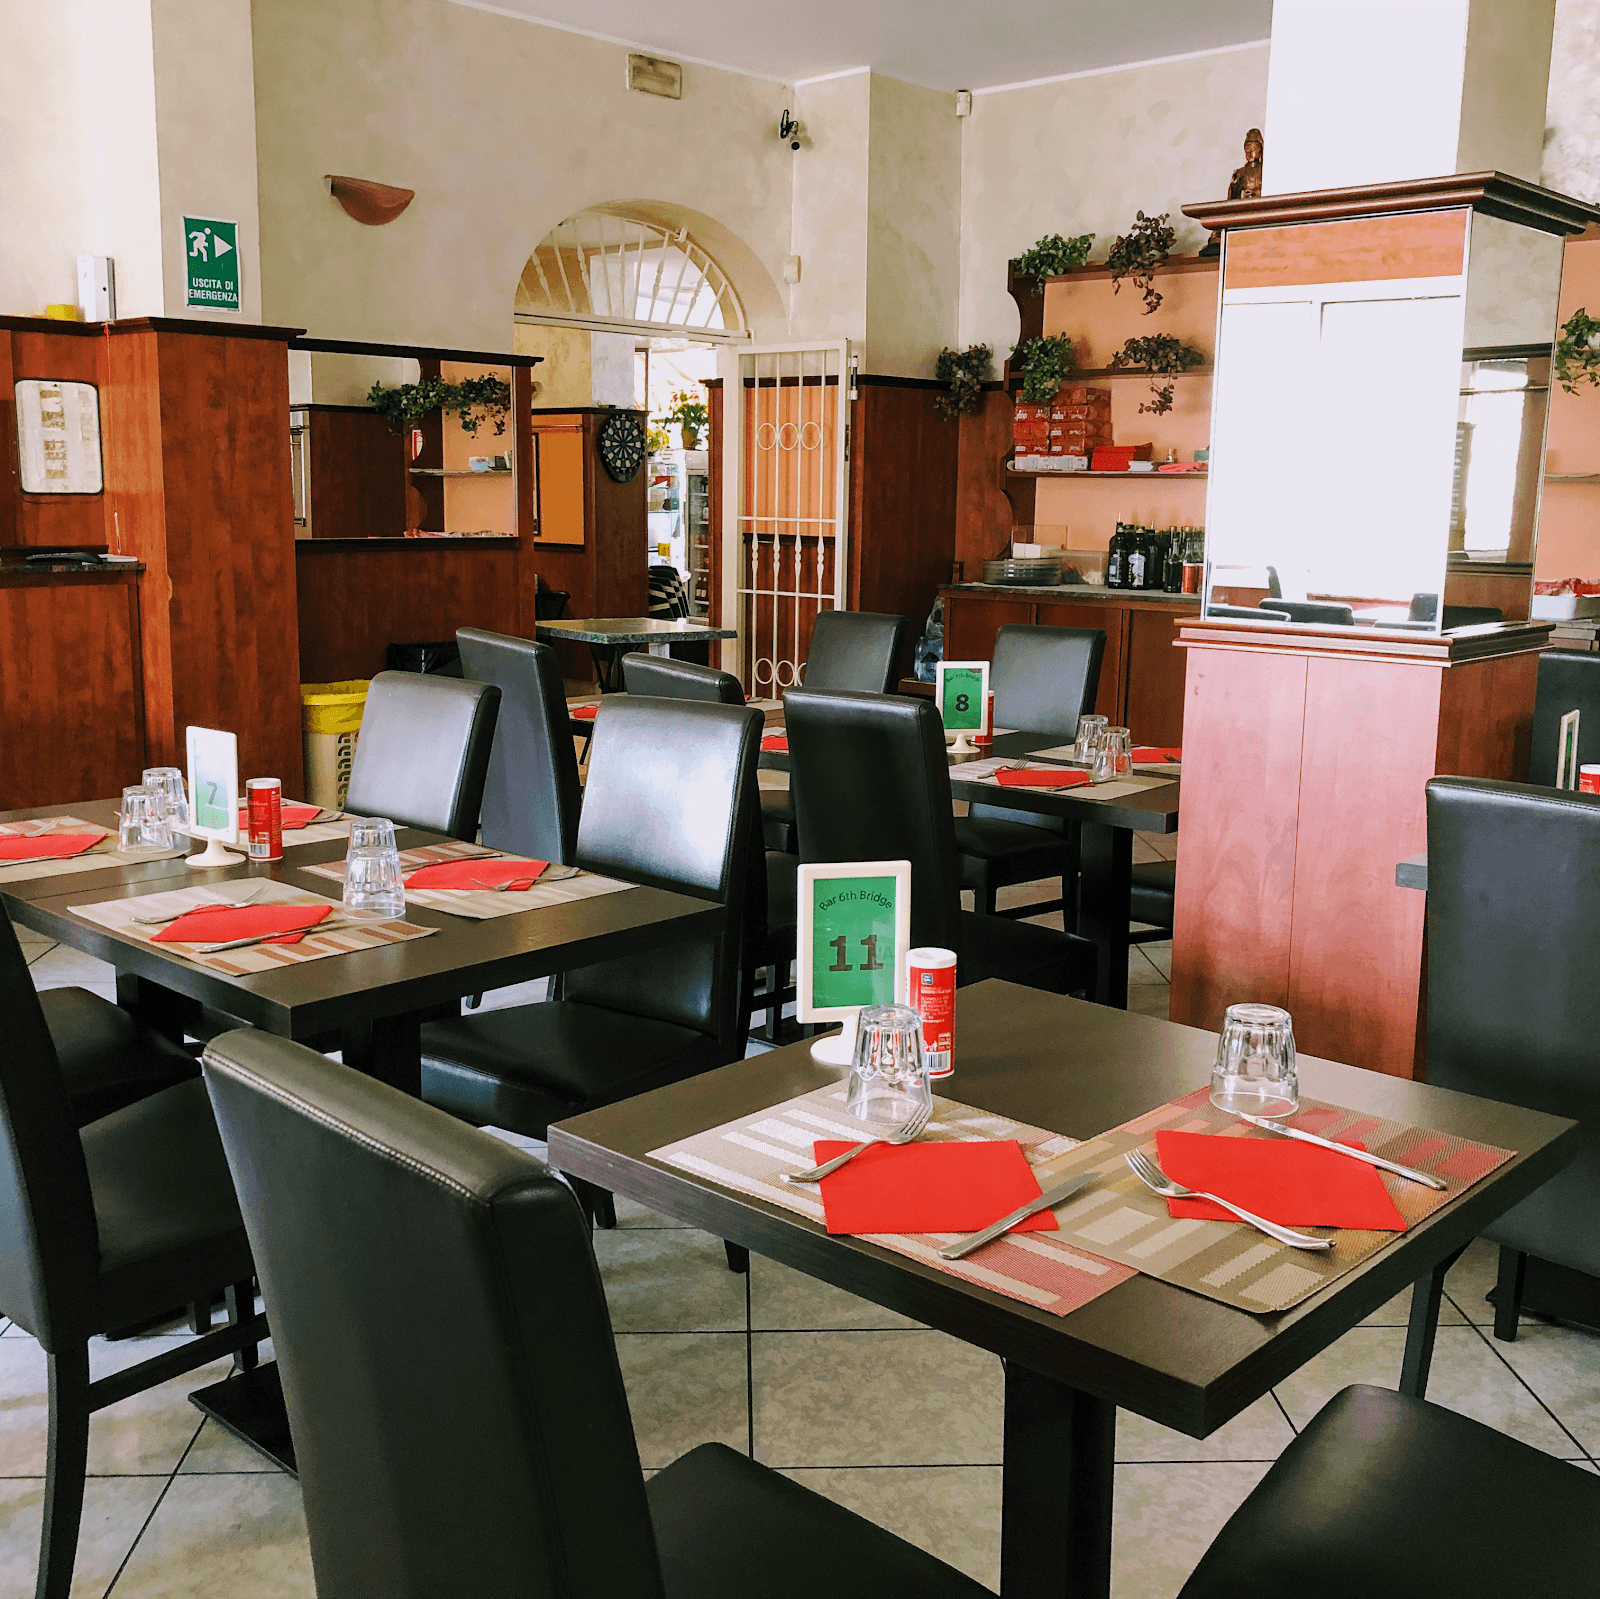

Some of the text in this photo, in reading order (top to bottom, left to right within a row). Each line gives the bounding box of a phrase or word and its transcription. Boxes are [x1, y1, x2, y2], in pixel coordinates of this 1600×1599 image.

[192, 277, 234, 291] USCITA DI
[188, 288, 238, 302] EMERGENZA
[956, 693, 970, 712] 8
[206, 780, 218, 805] 7
[818, 889, 893, 912] Bar 6th Bridge
[829, 934, 884, 972] 11
